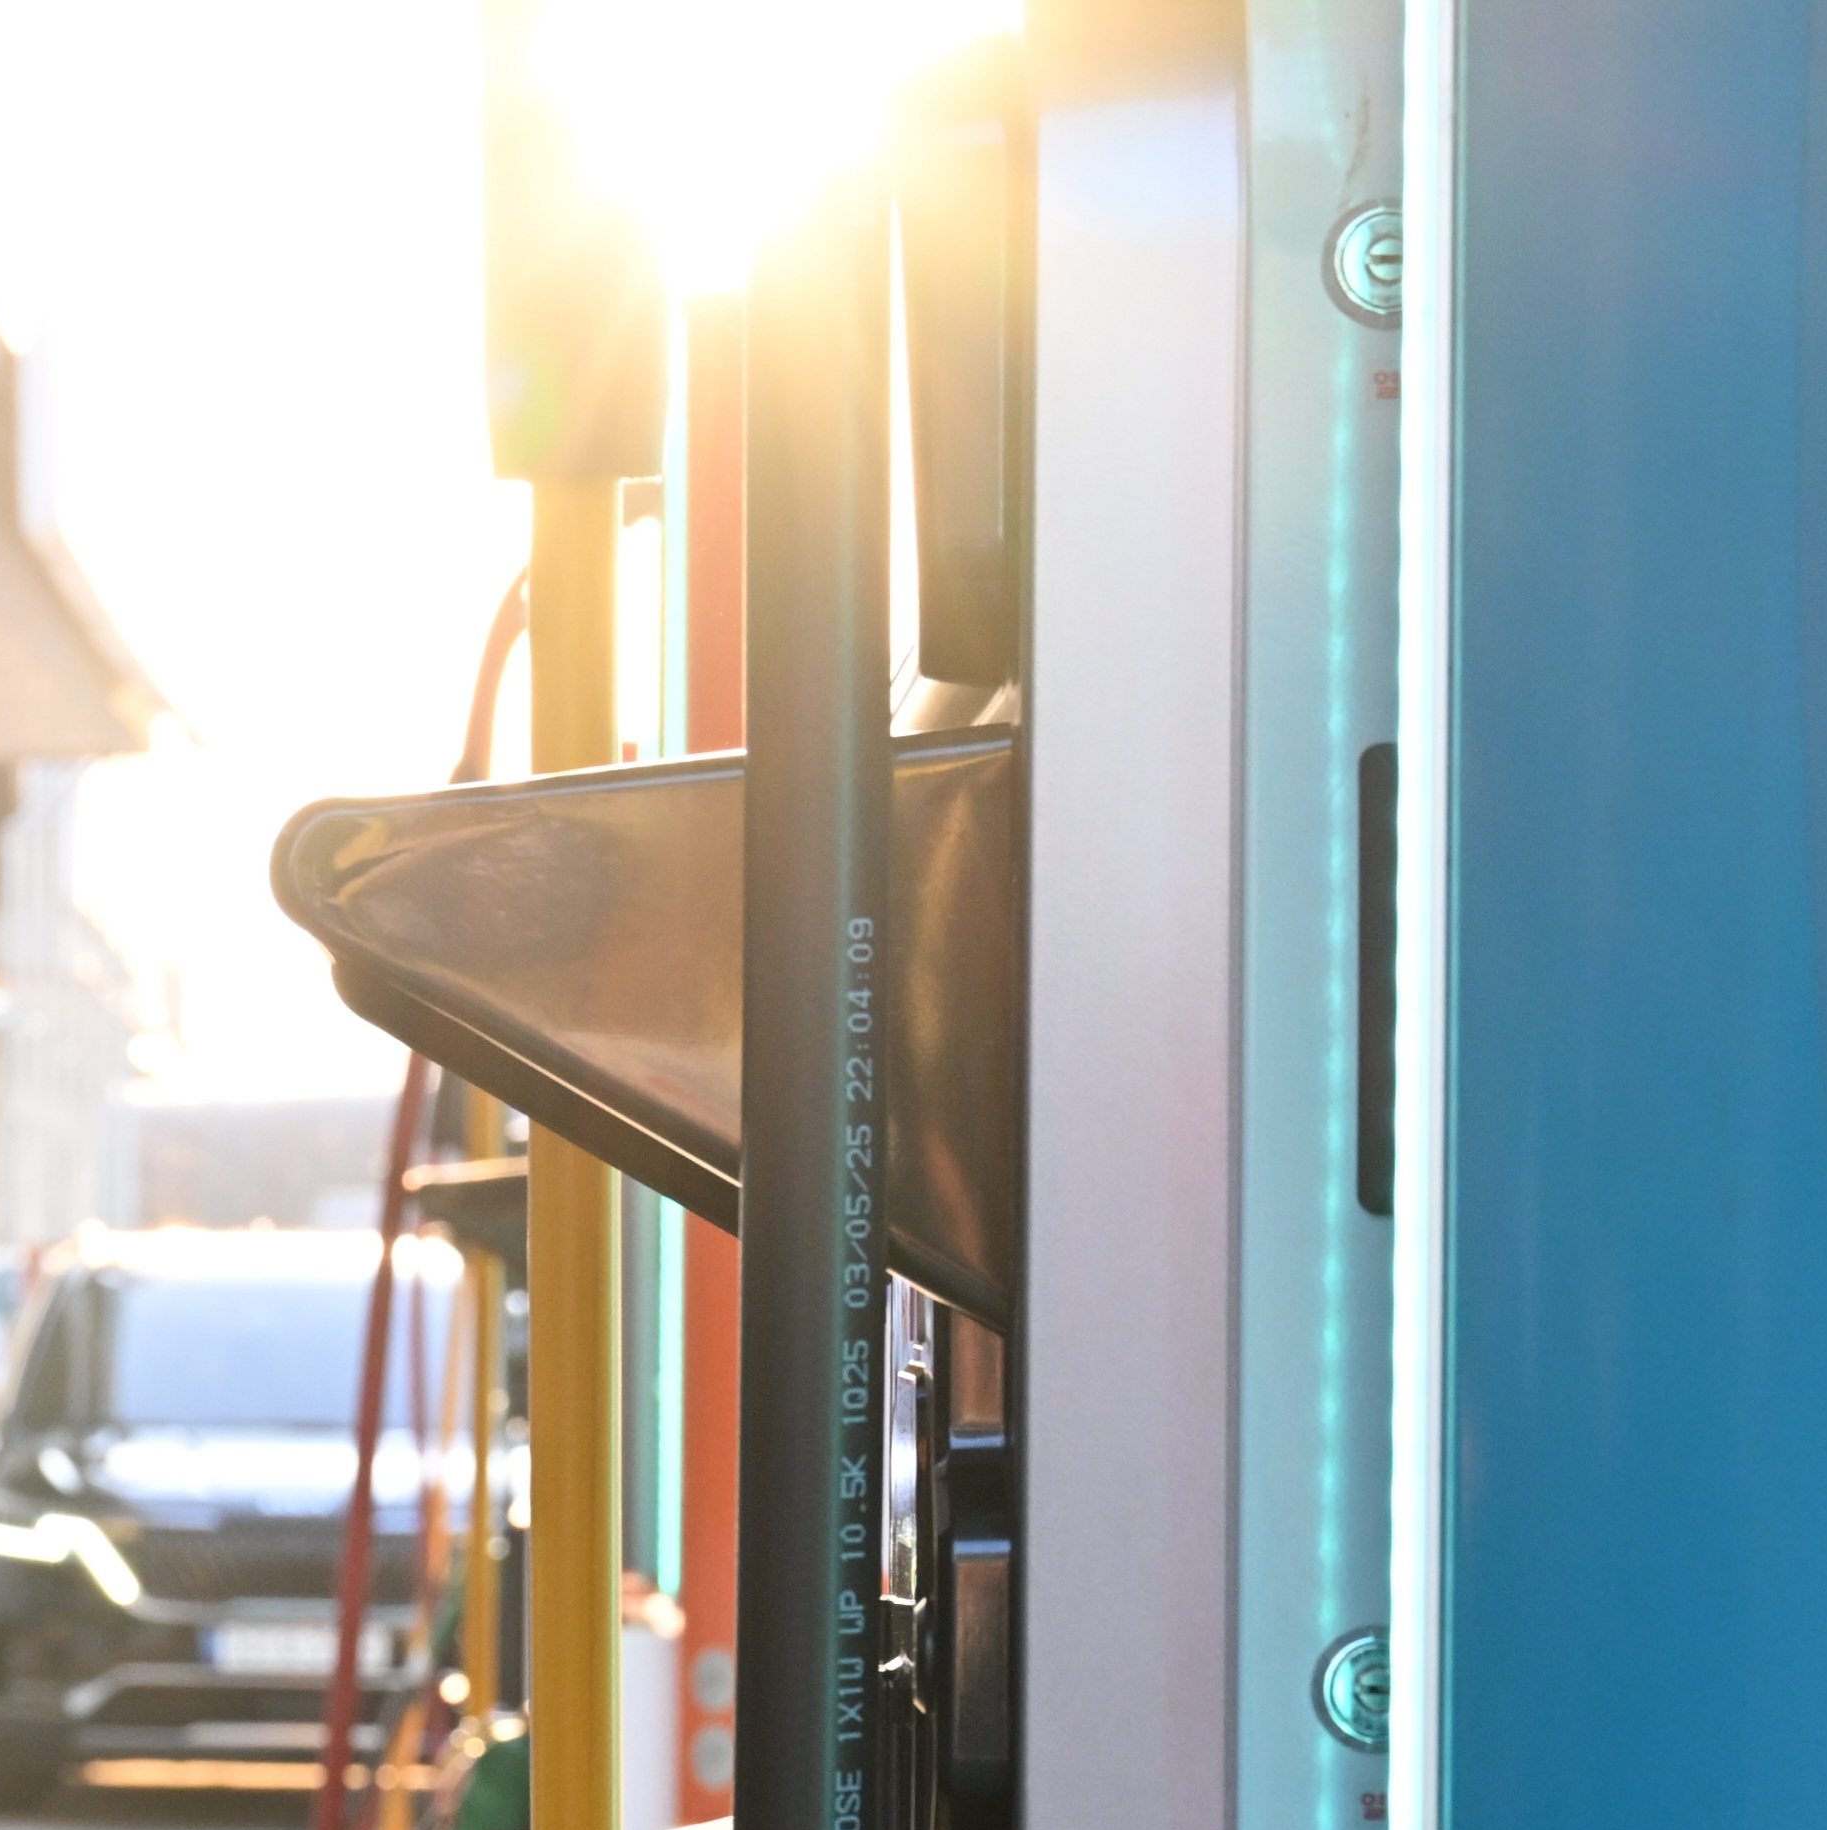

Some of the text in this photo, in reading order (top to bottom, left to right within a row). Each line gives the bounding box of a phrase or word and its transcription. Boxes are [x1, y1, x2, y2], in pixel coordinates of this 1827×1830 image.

[845, 917, 874, 1101] 22:04:09
[843, 1124, 873, 1309] 03/05/25
[841, 1339, 870, 1425] 1Q25
[837, 1590, 866, 1635] WP
[836, 1656, 865, 1742] 1X1W
